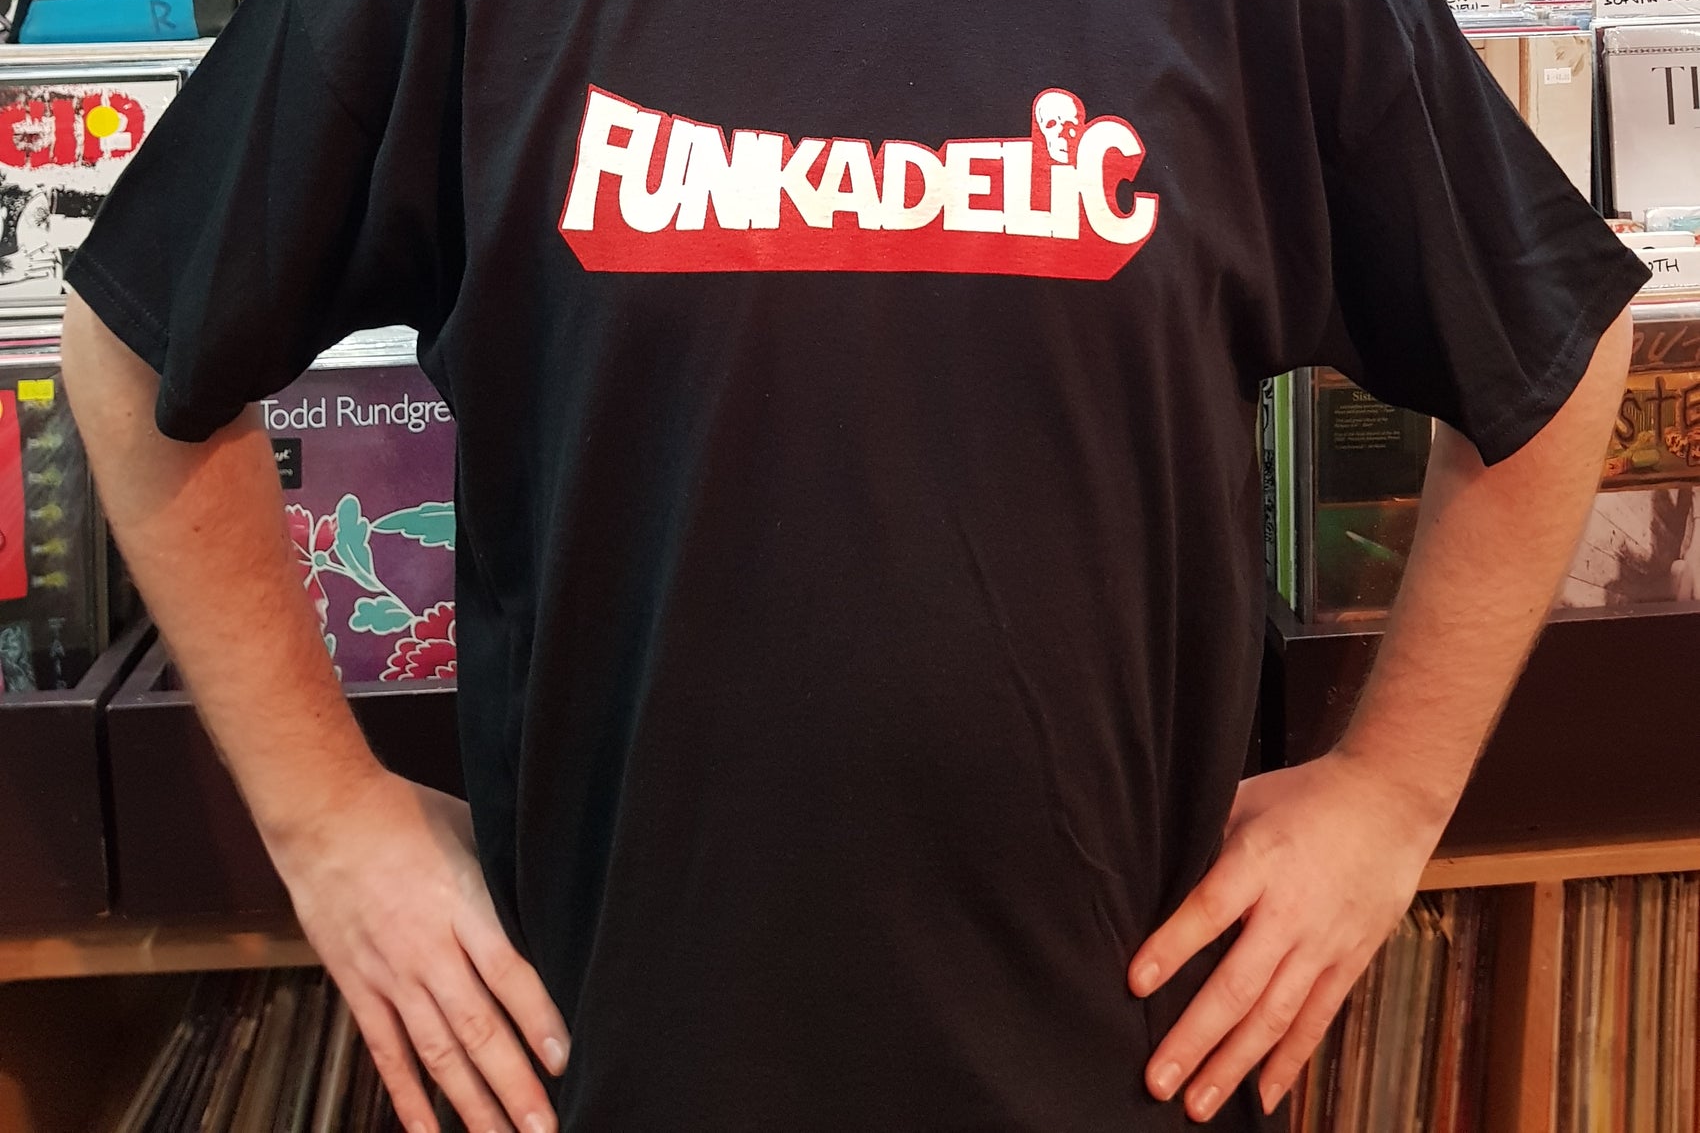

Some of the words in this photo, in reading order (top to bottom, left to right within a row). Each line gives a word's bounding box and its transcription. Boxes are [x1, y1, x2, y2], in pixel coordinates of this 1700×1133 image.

[150, 0, 176, 34] R
[260, 397, 327, 430] Todd
[337, 393, 455, 433] Rundgre
